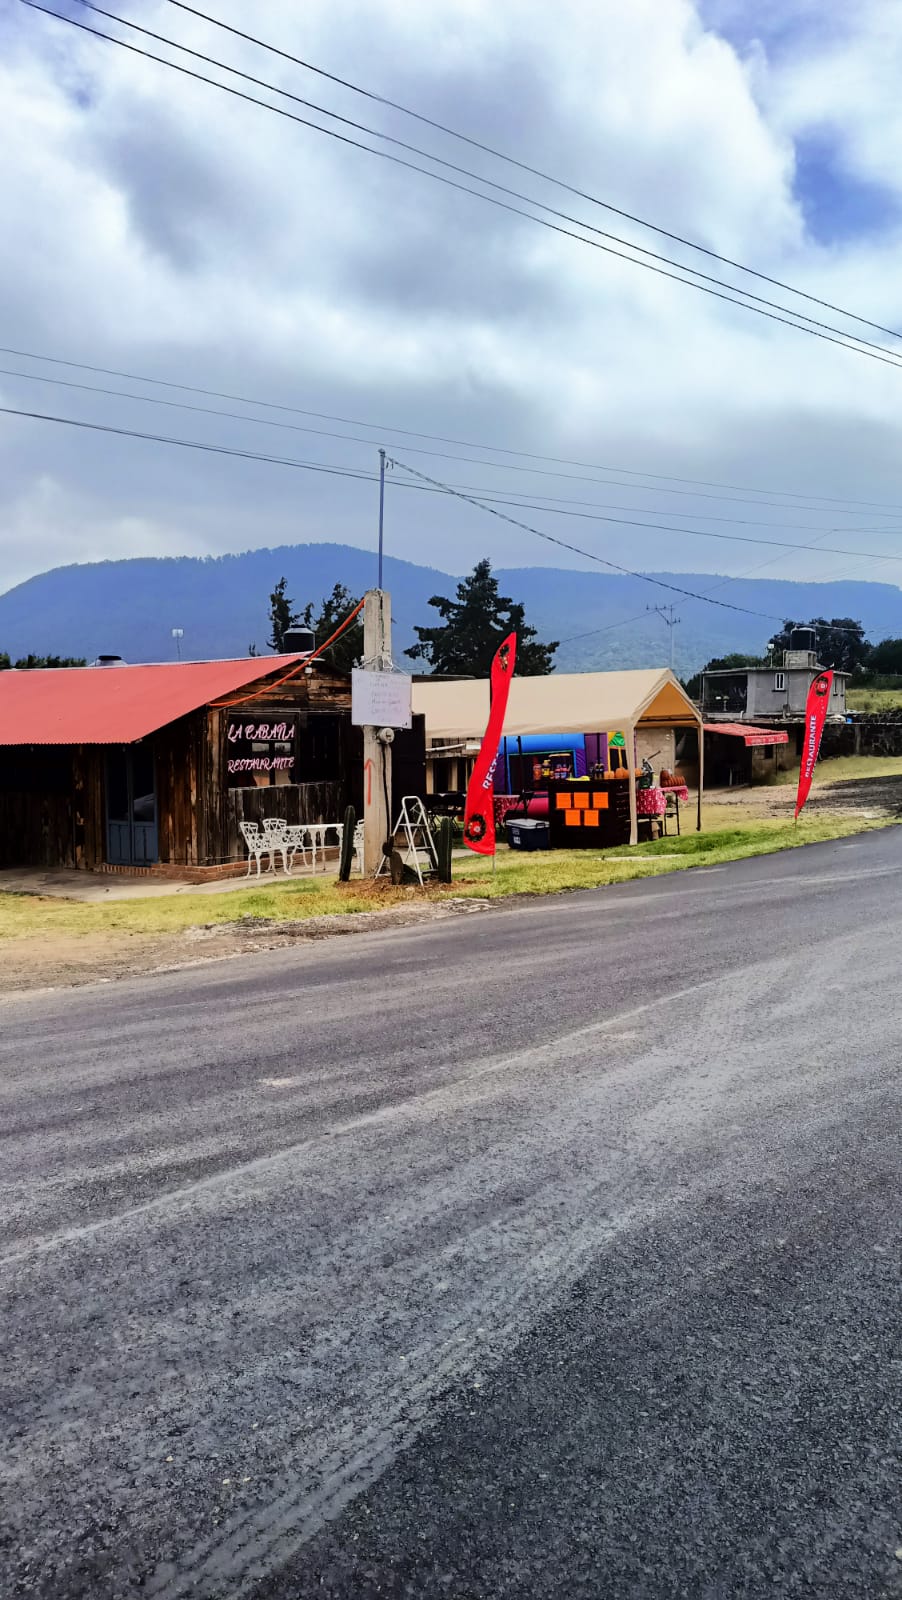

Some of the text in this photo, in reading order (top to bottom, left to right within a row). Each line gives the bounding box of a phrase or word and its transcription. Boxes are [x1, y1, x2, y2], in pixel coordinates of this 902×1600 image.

[228, 723, 295, 742] LA CABAÑA
[805, 715, 817, 778] RESTAURANTE
[227, 756, 295, 774] RESTAURANTE
